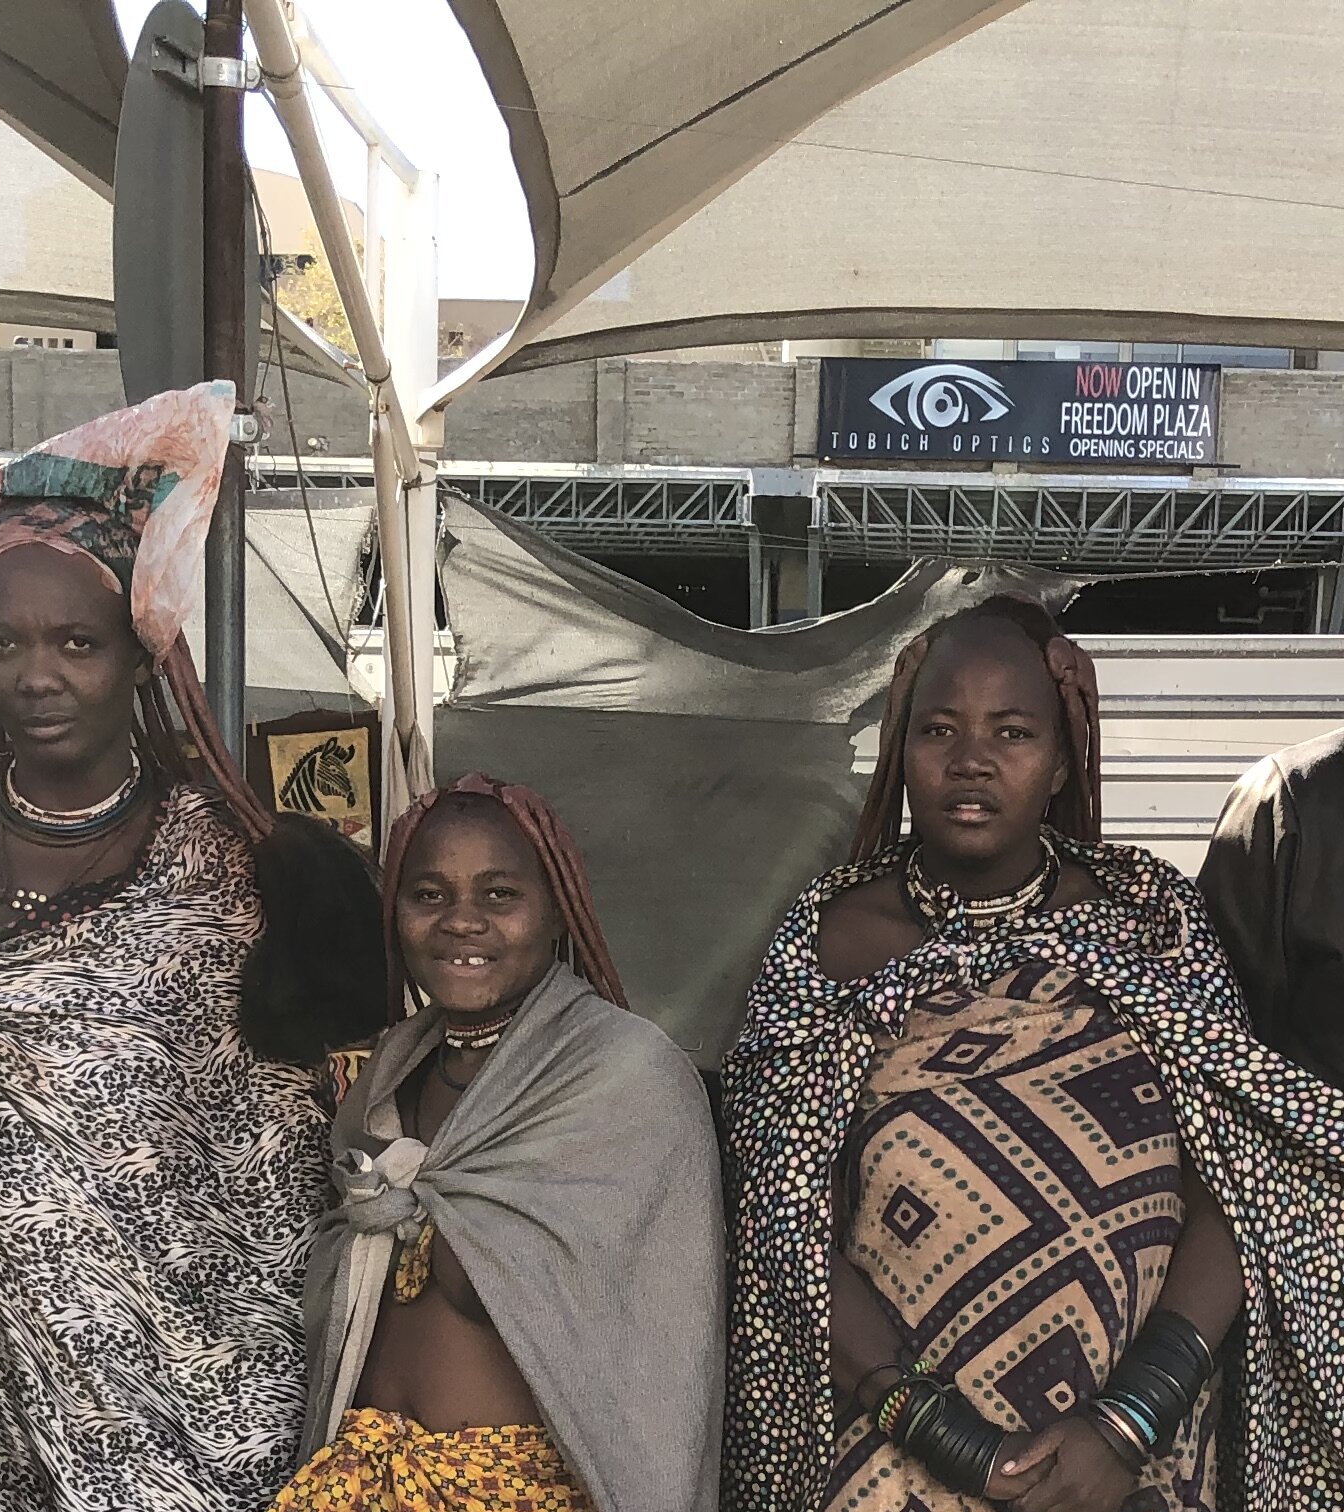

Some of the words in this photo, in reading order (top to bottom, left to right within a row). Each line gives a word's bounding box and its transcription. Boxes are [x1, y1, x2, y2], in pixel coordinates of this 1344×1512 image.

[1075, 363, 1122, 400] NOW
[1126, 366, 1175, 400] OPEN
[1181, 366, 1200, 400] IN
[1060, 402, 1149, 436] FREEDOM
[1153, 403, 1212, 438] PLAZA
[830, 431, 931, 452] TOBICH
[952, 434, 1051, 455] OPTICS
[1069, 439, 1136, 459] OPENING
[1138, 440, 1205, 460] SPECIALS
